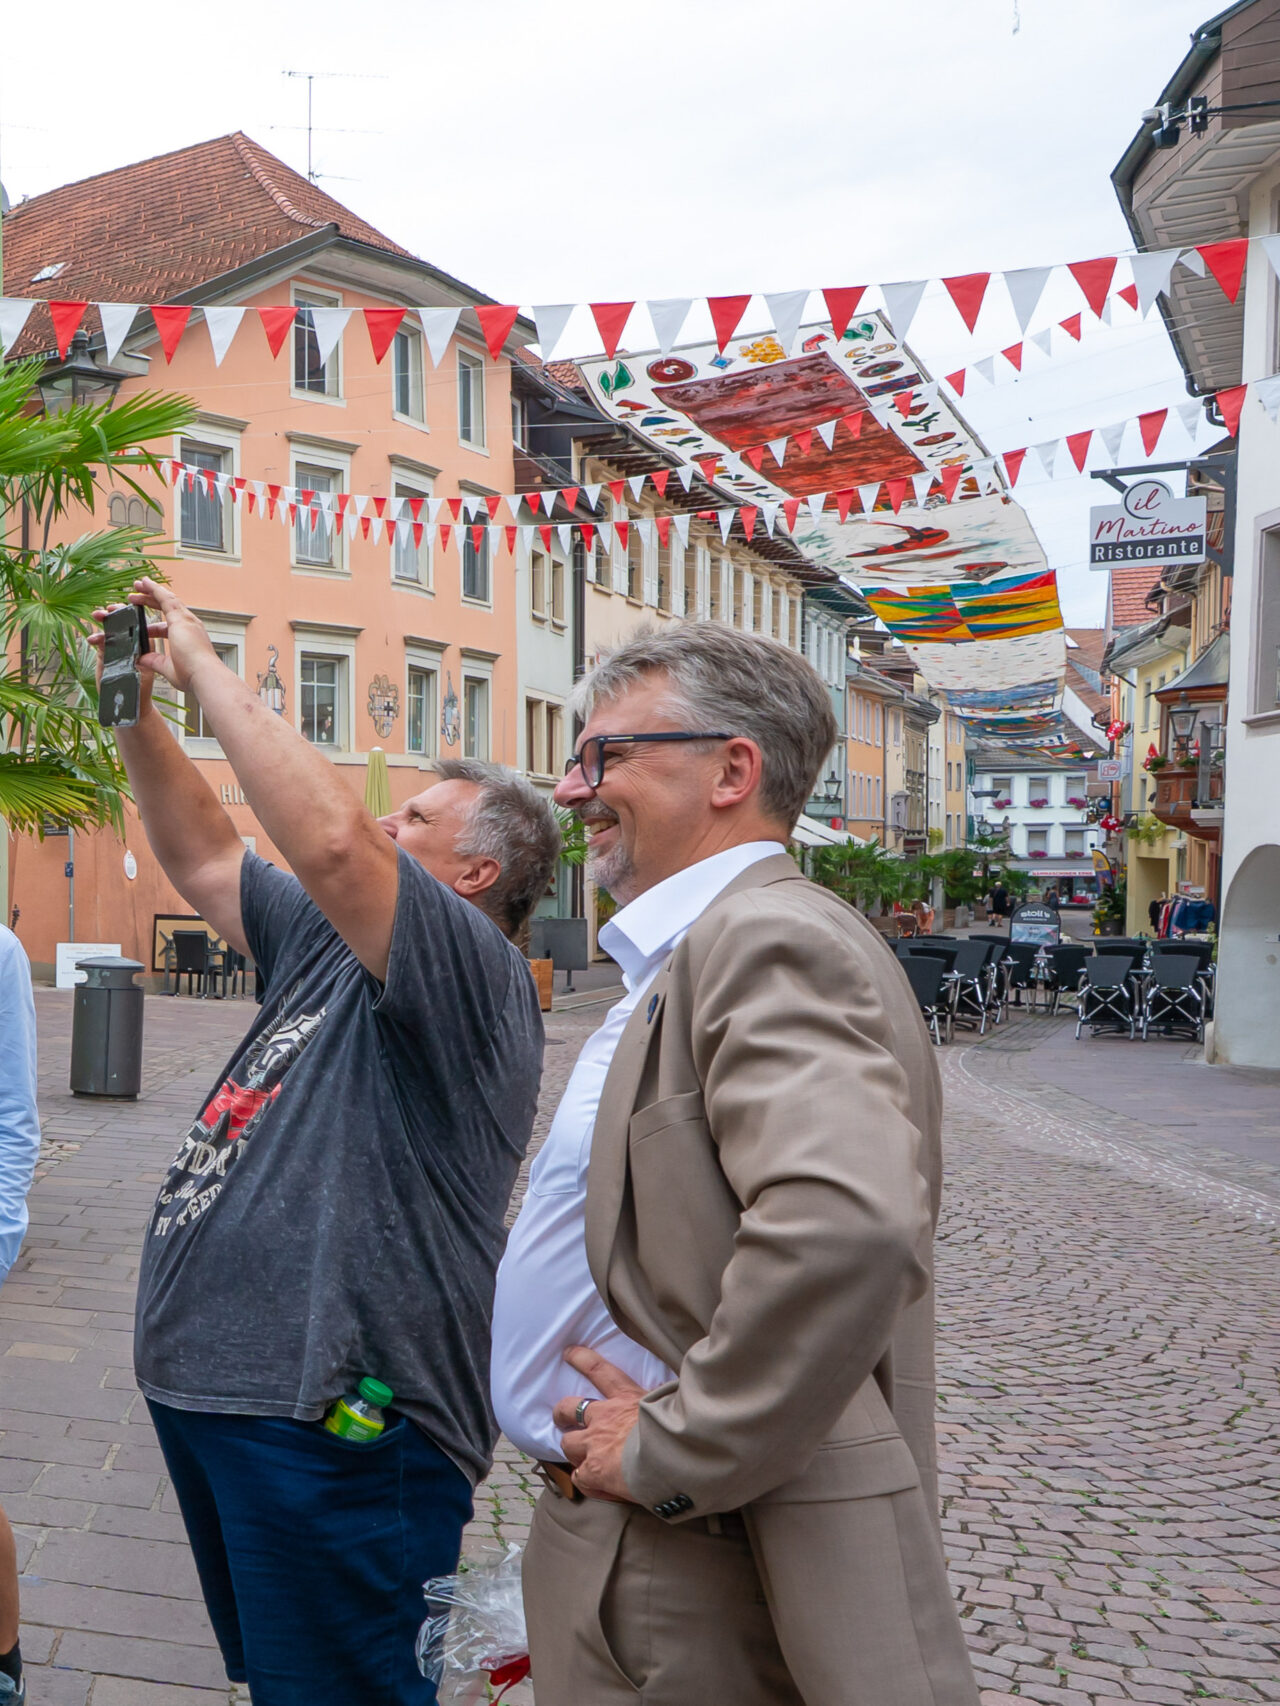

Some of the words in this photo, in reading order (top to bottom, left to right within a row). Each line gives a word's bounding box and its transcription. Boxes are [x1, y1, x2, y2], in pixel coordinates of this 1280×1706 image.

[1134, 488, 1161, 511] il
[1095, 517, 1203, 544] Martino
[1095, 540, 1199, 561] Ristorante
